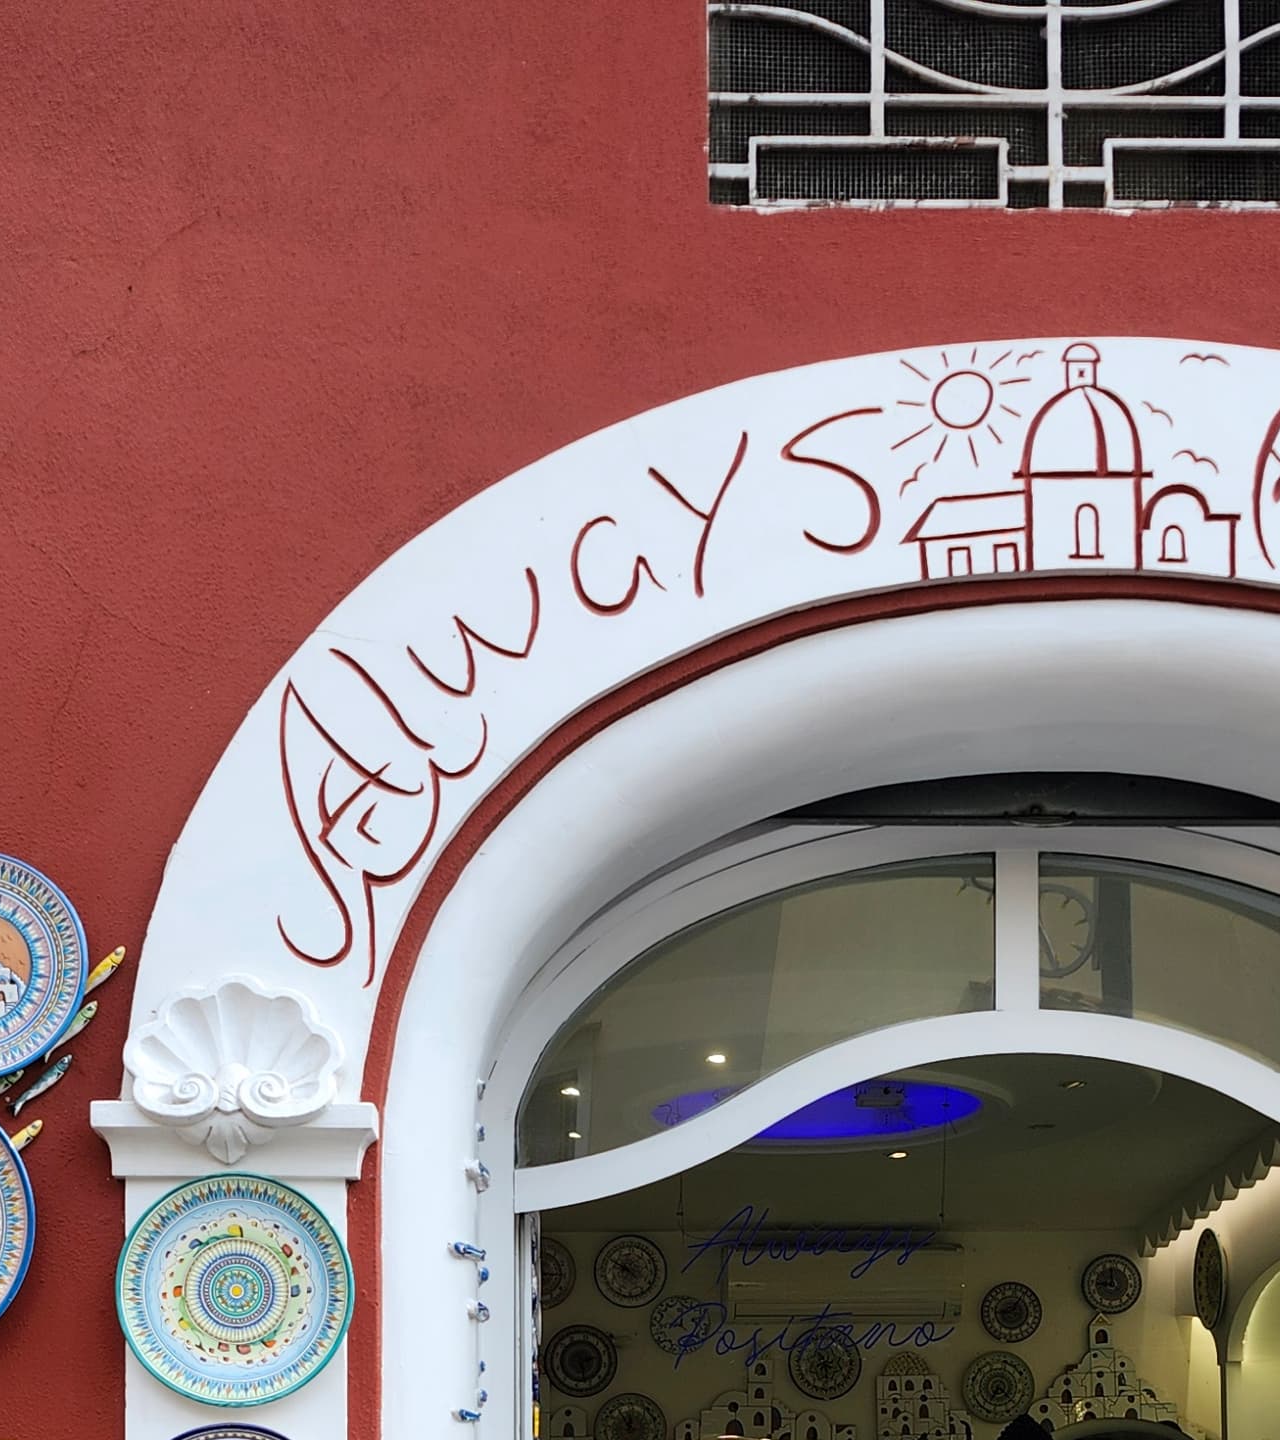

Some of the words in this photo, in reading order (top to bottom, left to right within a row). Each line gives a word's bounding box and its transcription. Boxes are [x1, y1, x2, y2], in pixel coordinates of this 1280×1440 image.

[277, 407, 883, 989] Always
[680, 1205, 937, 1285] Always
[669, 1302, 955, 1370] Positano
